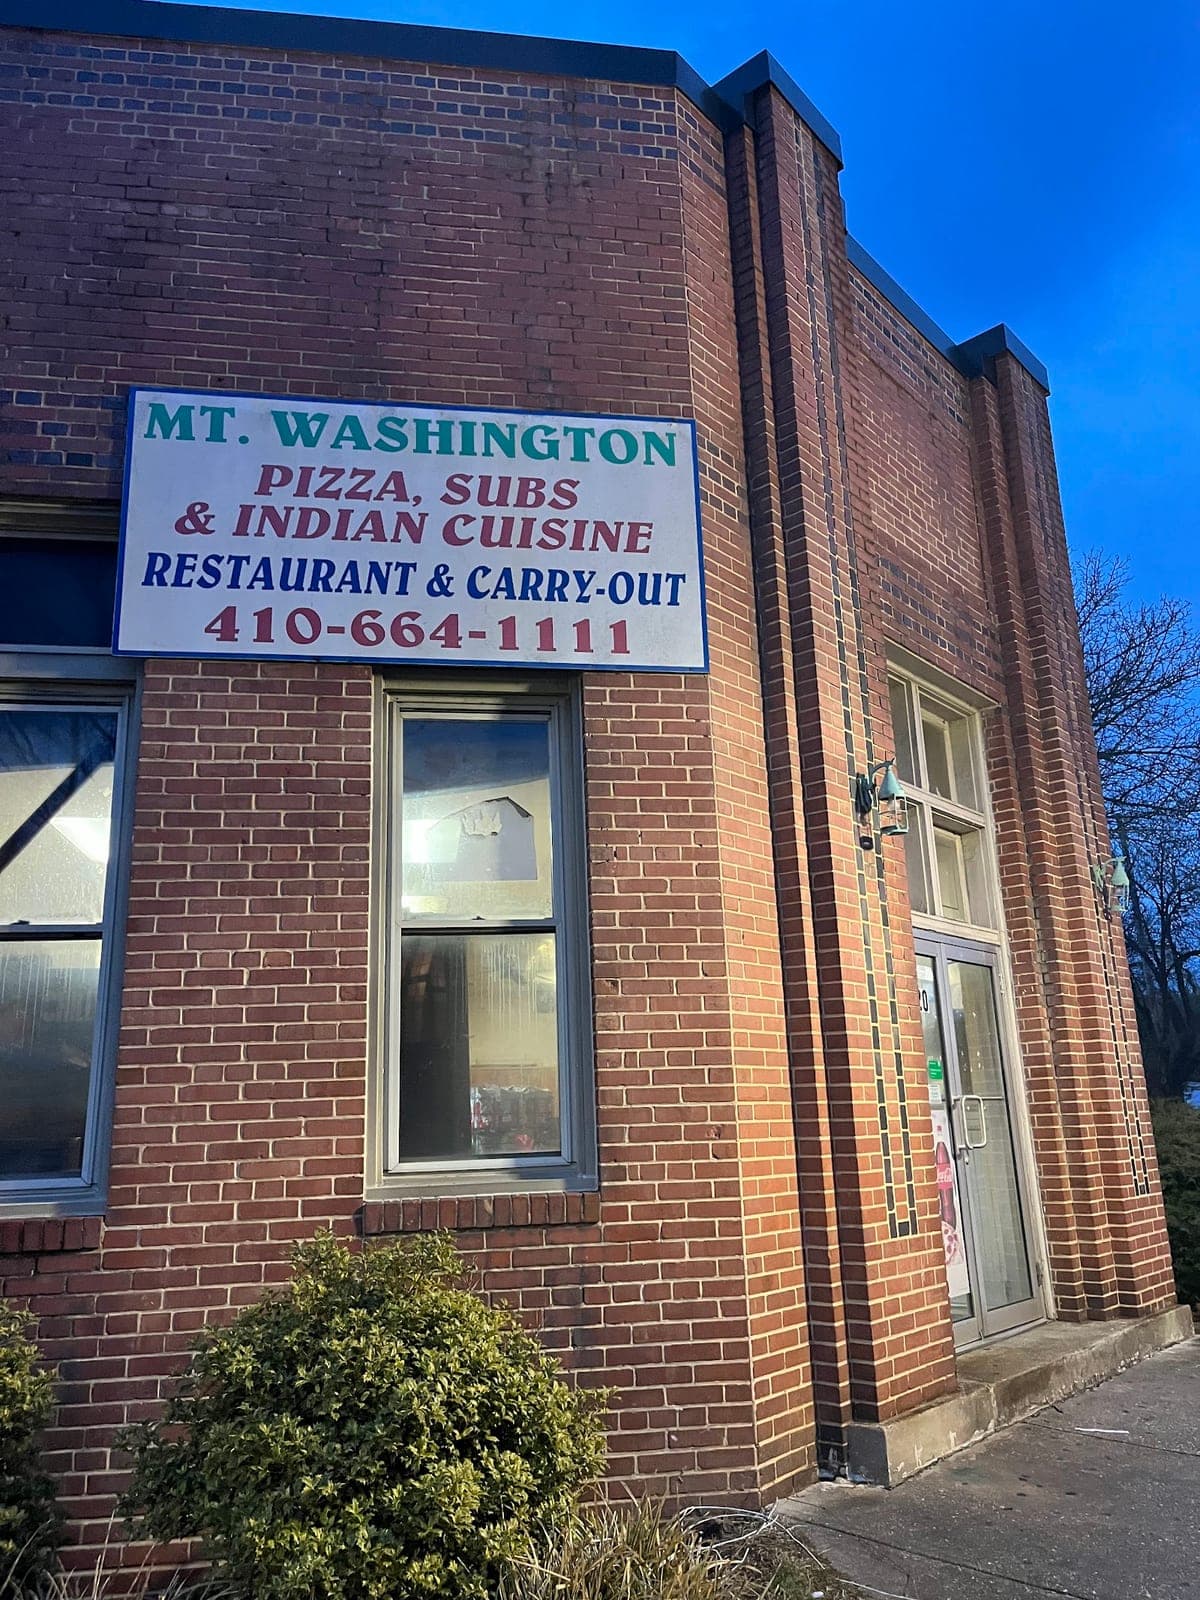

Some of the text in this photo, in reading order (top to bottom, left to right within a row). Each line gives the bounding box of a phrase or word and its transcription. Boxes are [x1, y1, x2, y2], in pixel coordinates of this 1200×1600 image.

[143, 402, 677, 467] MT. WASHINGTON
[254, 464, 581, 511] PIZZA, SUBS
[174, 501, 654, 554] & INDIAN CUISINE
[141, 551, 687, 607] RESTAURANT & CARRY-OUT
[204, 605, 632, 655] 410-664-1111
